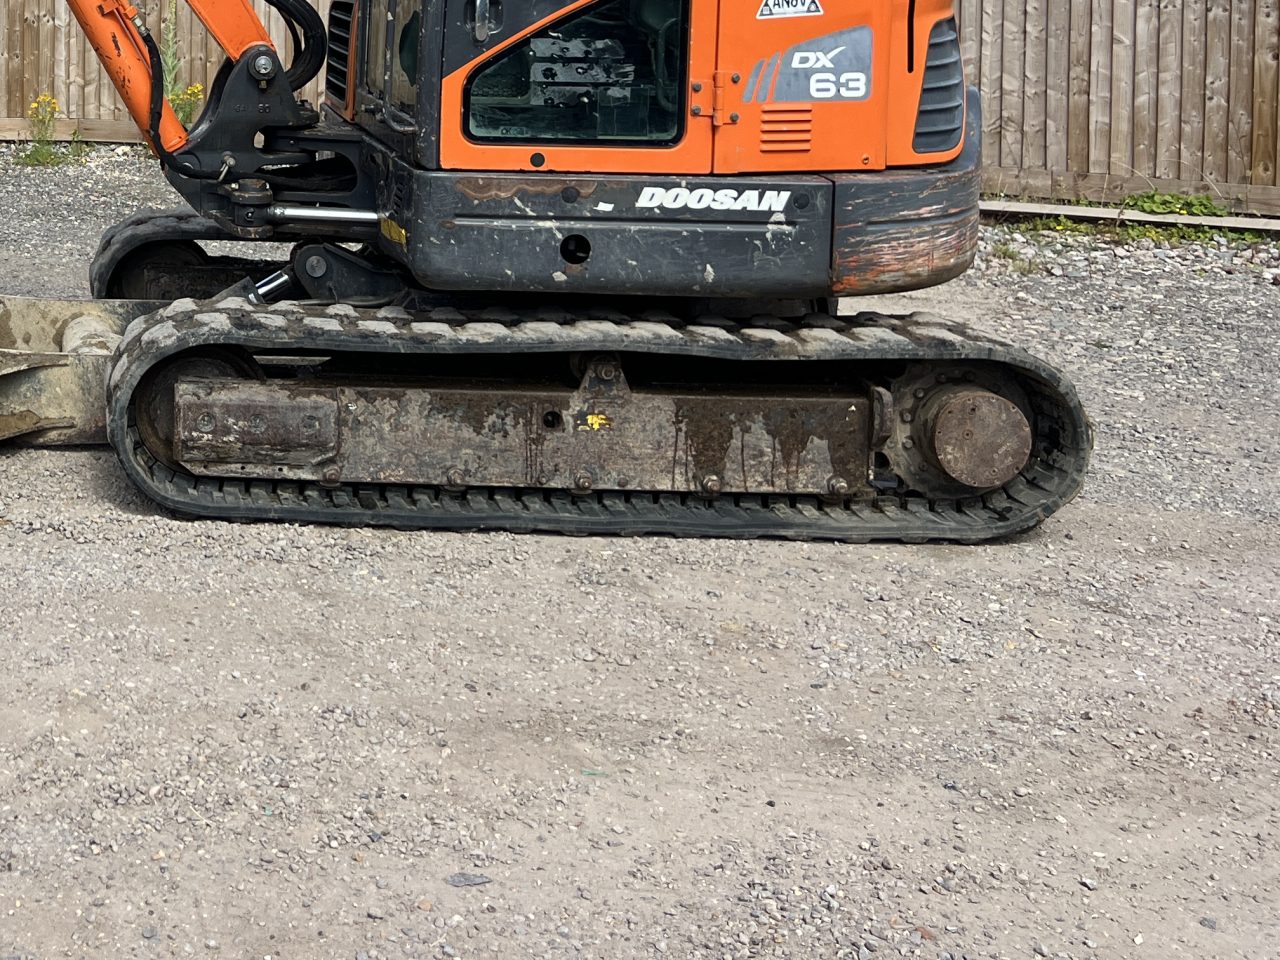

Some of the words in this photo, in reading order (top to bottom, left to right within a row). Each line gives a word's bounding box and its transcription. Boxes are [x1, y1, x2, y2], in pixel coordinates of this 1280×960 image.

[791, 46, 846, 69] DX
[808, 72, 867, 98] 63
[635, 186, 791, 211] DOOSAN
